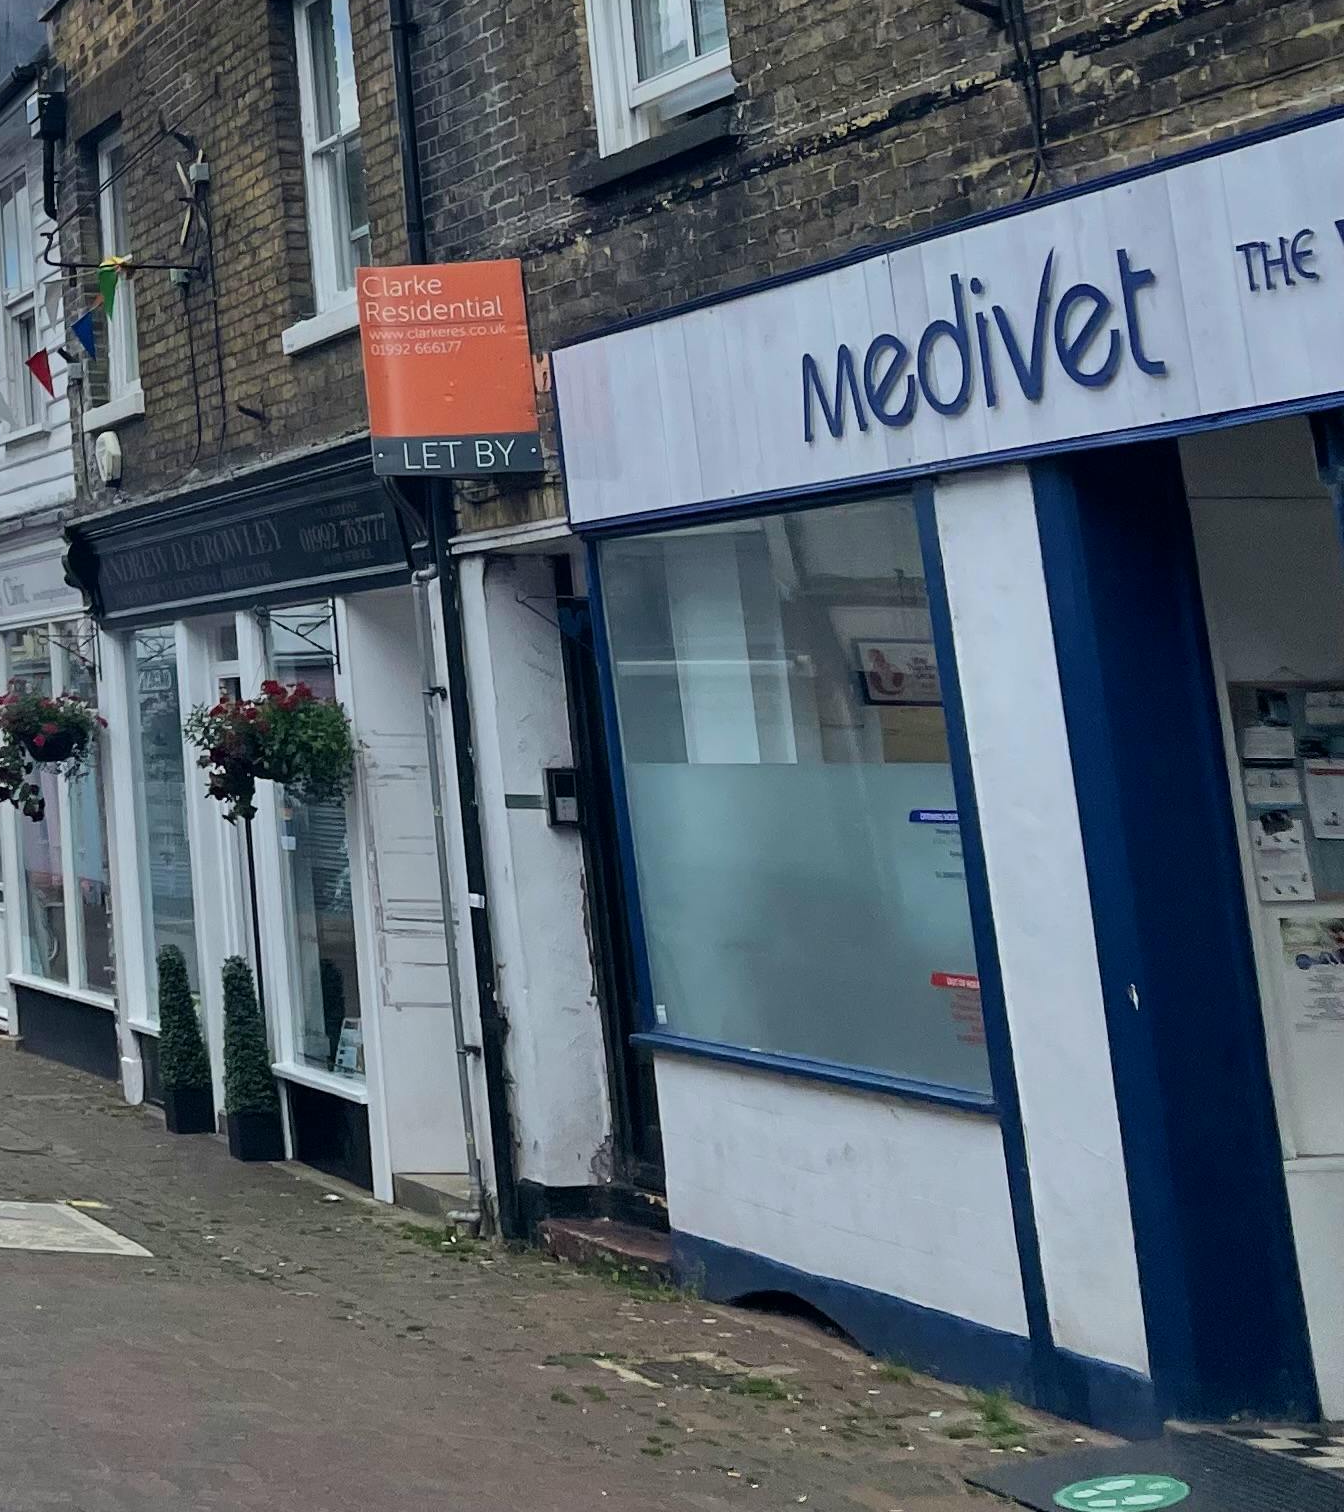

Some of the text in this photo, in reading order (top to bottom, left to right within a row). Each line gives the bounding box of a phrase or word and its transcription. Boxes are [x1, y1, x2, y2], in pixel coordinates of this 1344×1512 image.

[1236, 228, 1320, 292] THE
[362, 276, 443, 299] Clarke
[365, 295, 504, 323] Residential
[368, 324, 508, 341] www.clarkeres.co.uk
[370, 341, 462, 357] 01992 666177
[403, 439, 515, 470] LET BY
[101, 546, 166, 586] ANDREW
[192, 517, 283, 568] CROWLEY
[299, 520, 340, 553] 01992
